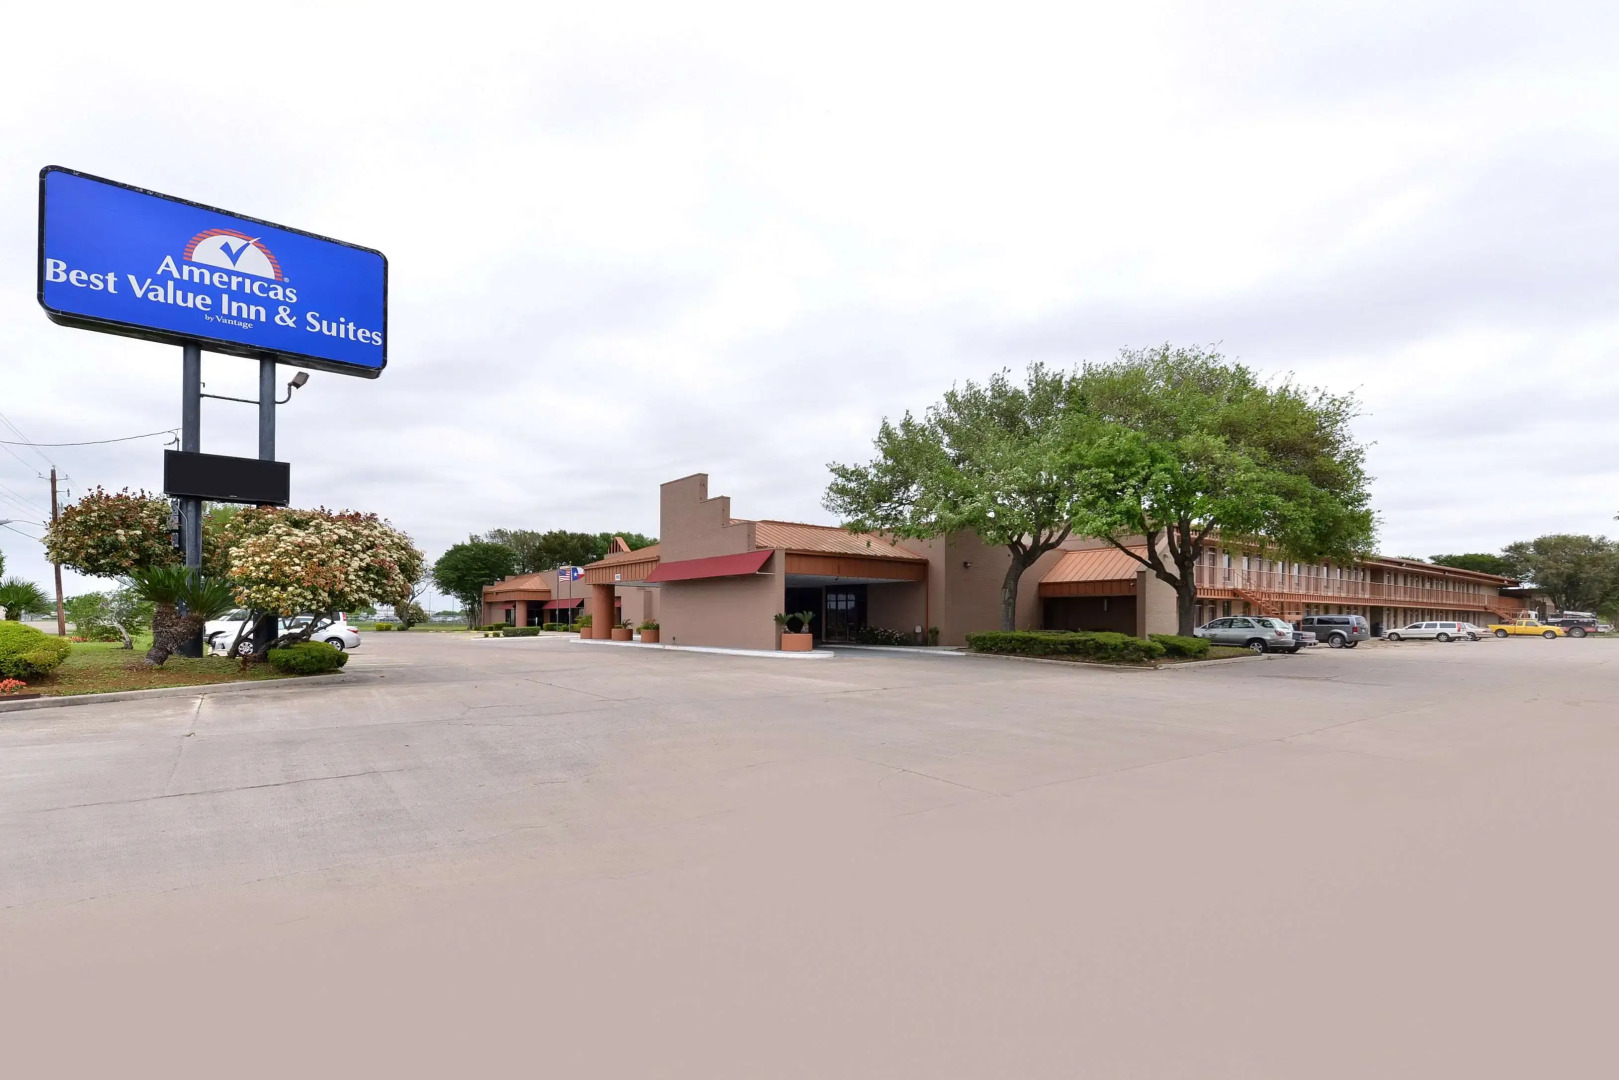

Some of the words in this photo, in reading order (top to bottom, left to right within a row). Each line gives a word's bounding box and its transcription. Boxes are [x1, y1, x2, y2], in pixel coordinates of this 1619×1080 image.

[45, 258, 118, 294] Best
[127, 274, 212, 311] Value
[221, 293, 266, 322] Inn
[274, 305, 297, 328] &
[306, 311, 383, 346] Suites
[156, 255, 298, 303] Americas
[204, 313, 214, 322] by
[215, 314, 254, 329] Vantage
